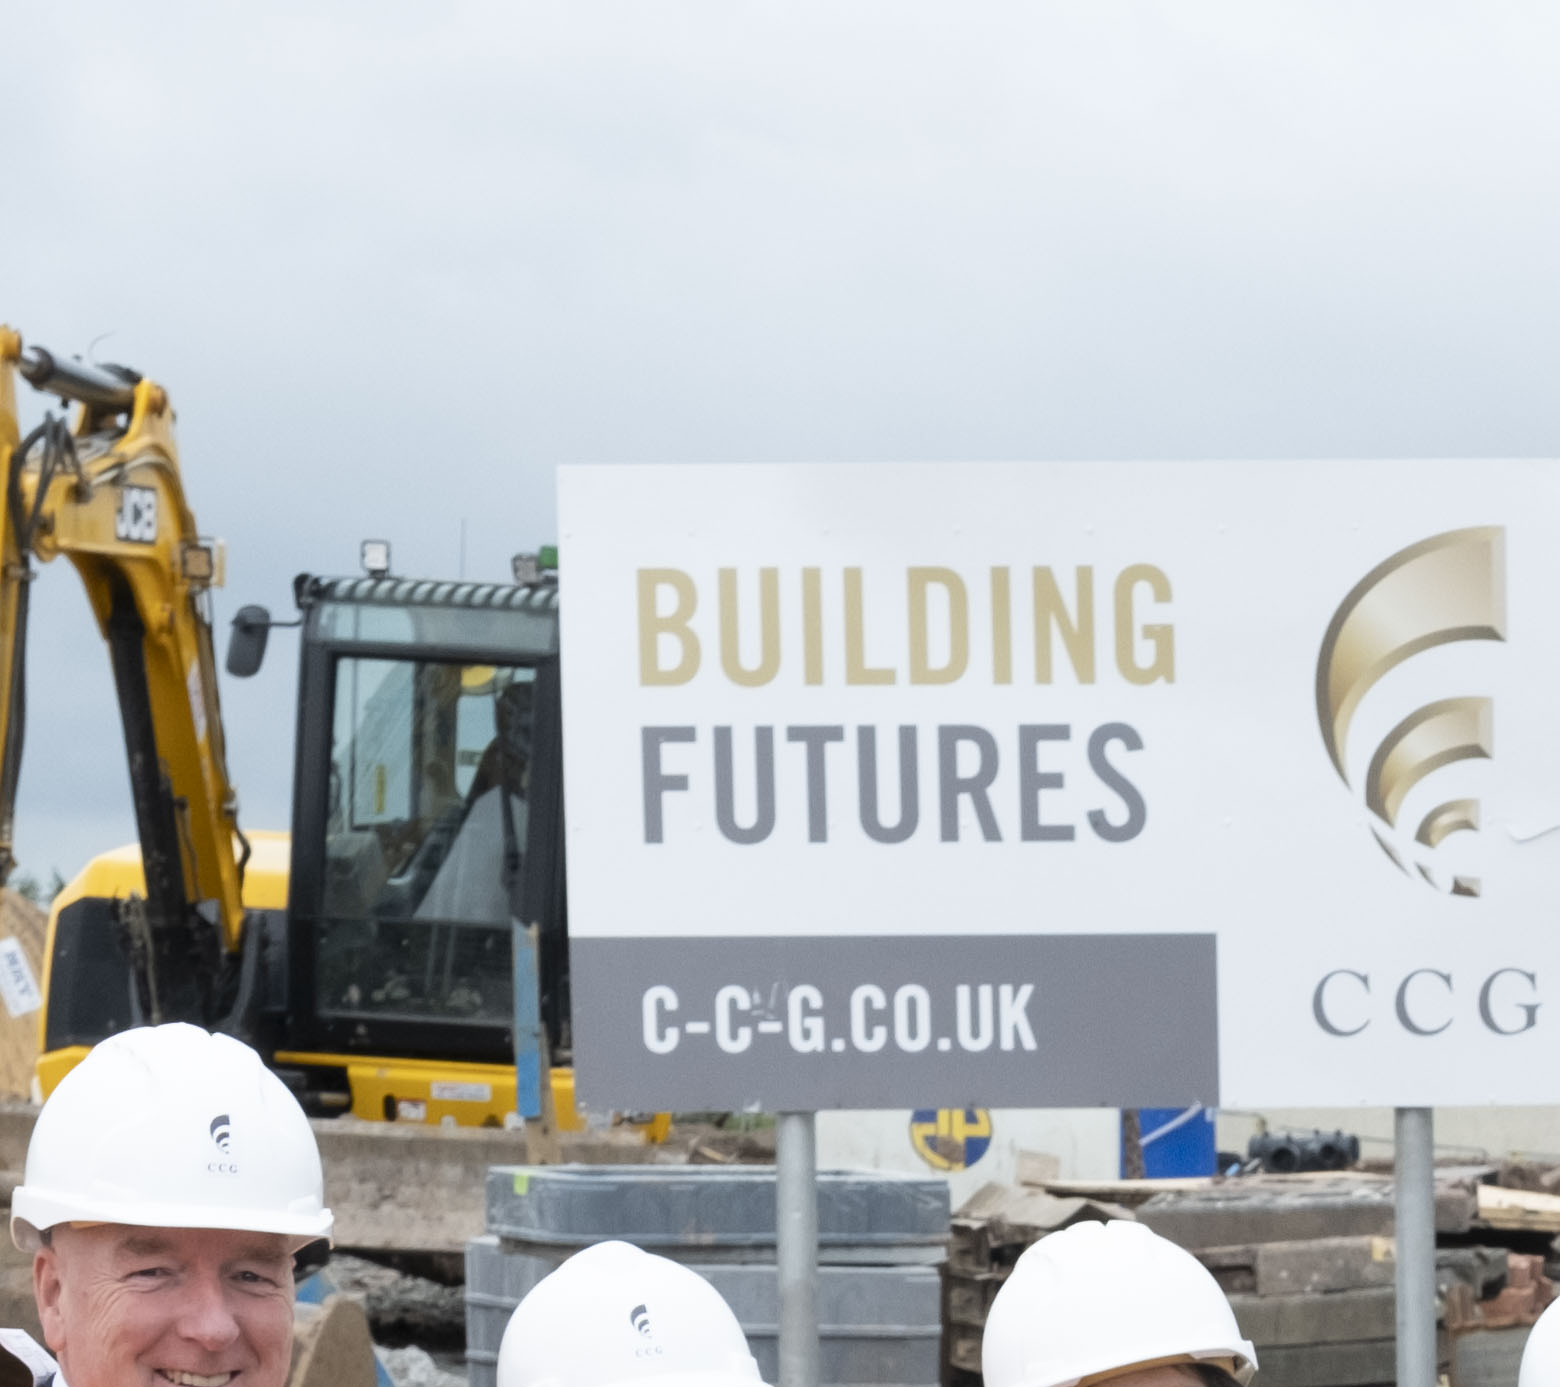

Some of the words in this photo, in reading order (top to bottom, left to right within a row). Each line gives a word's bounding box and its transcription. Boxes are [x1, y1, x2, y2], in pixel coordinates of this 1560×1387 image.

[116, 487, 157, 543] JCB
[637, 563, 1176, 688] BUILDING
[641, 722, 1147, 845] FUTURES
[642, 984, 1037, 1054] C-C-G.CO.UK
[1312, 968, 1540, 1037] CCG
